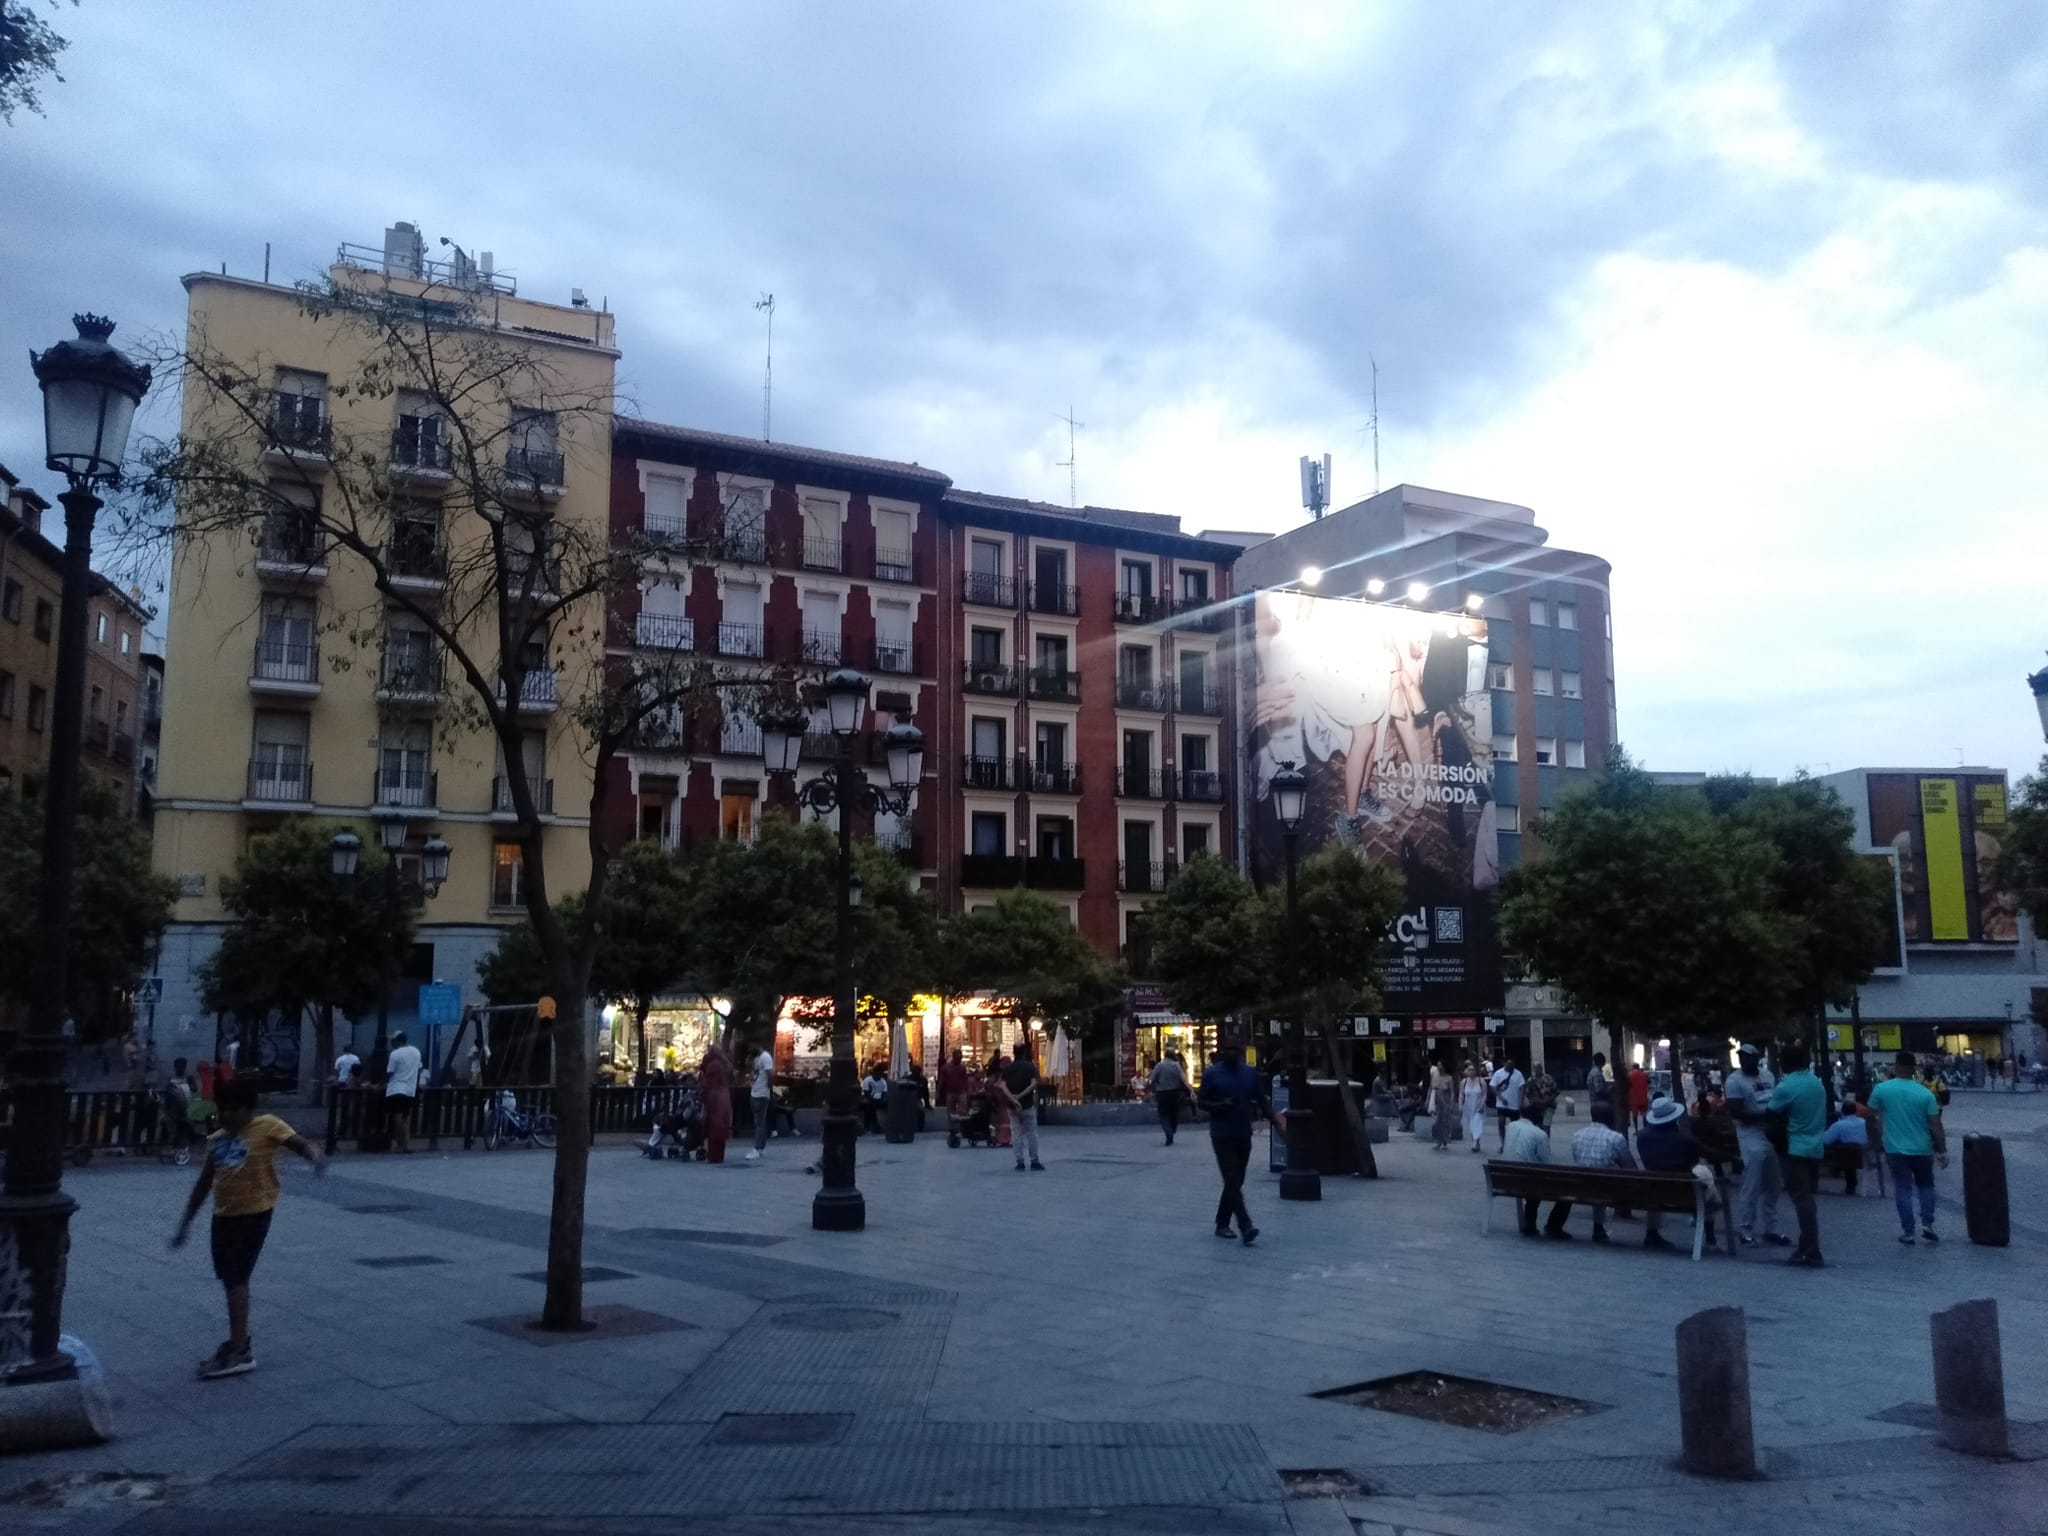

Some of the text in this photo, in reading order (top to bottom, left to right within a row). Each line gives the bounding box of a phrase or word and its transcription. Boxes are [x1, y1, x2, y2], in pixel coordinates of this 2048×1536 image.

[1377, 761, 1488, 784] LA DIVERSIÓN
[1378, 782, 1398, 799] ES
